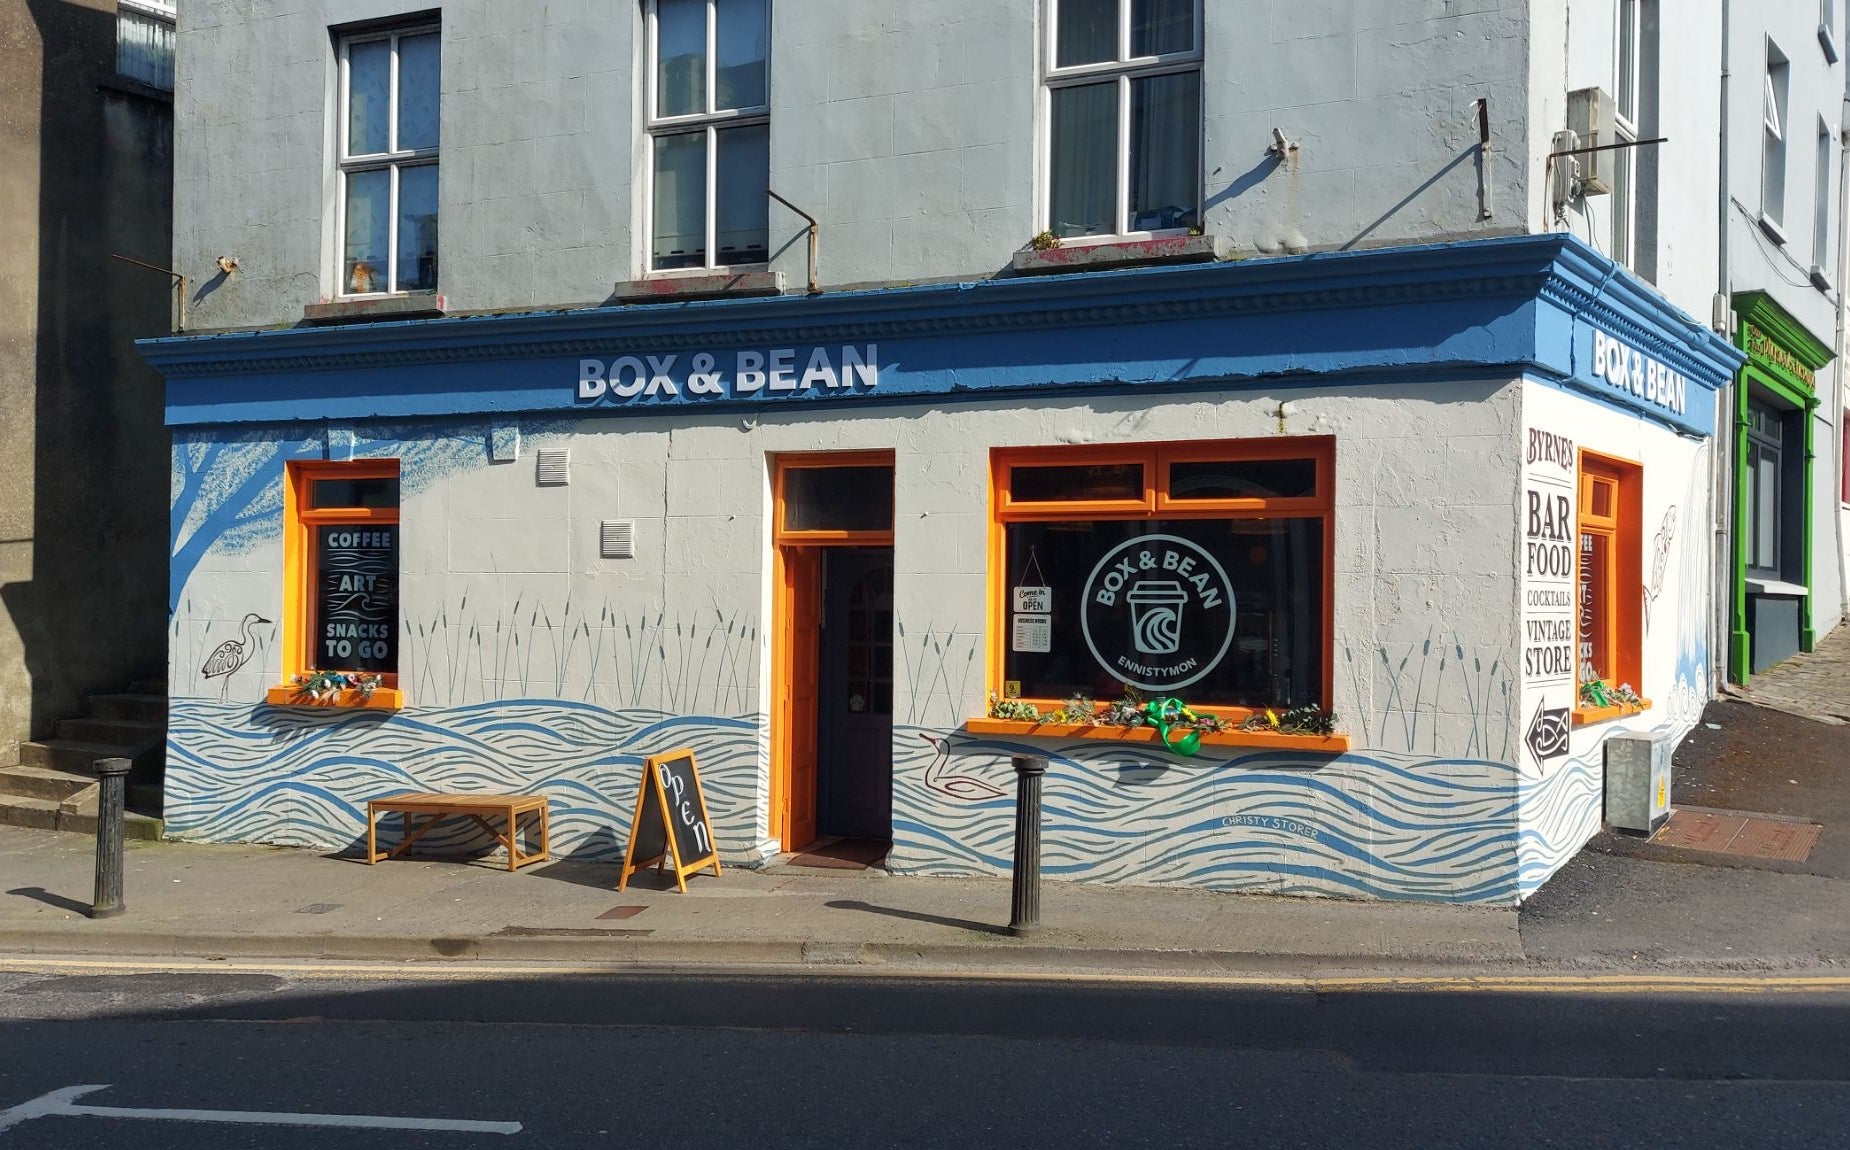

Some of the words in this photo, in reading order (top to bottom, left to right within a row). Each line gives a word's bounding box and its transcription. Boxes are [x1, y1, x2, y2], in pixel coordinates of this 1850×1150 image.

[579, 354, 678, 399] BOX
[687, 352, 724, 395] &
[736, 344, 878, 392] BEAN
[1593, 328, 1631, 391] BOX
[1632, 350, 1645, 397] &
[1646, 358, 1686, 415] BEAN
[1527, 427, 1573, 471] BYRNES
[1527, 489, 1572, 541] BAR
[328, 532, 391, 548] COFFEE
[1527, 542, 1571, 578] FOOD
[339, 574, 376, 592] ART
[1096, 556, 1138, 607] BOX
[1139, 550, 1158, 570] &
[1162, 550, 1223, 610] BEAN
[1022, 601, 1043, 611] OPEN
[1527, 589, 1571, 607] COCKTAILS
[326, 623, 389, 639] SNACKS
[1527, 619, 1571, 642] VINTAGE
[326, 639, 352, 658] TO
[358, 640, 388, 659] GO
[1526, 645, 1571, 676] STORE
[1117, 655, 1198, 677] ENNISTYMON
[1221, 816, 1269, 827] CHRISTY
[1272, 818, 1319, 840] STORER
